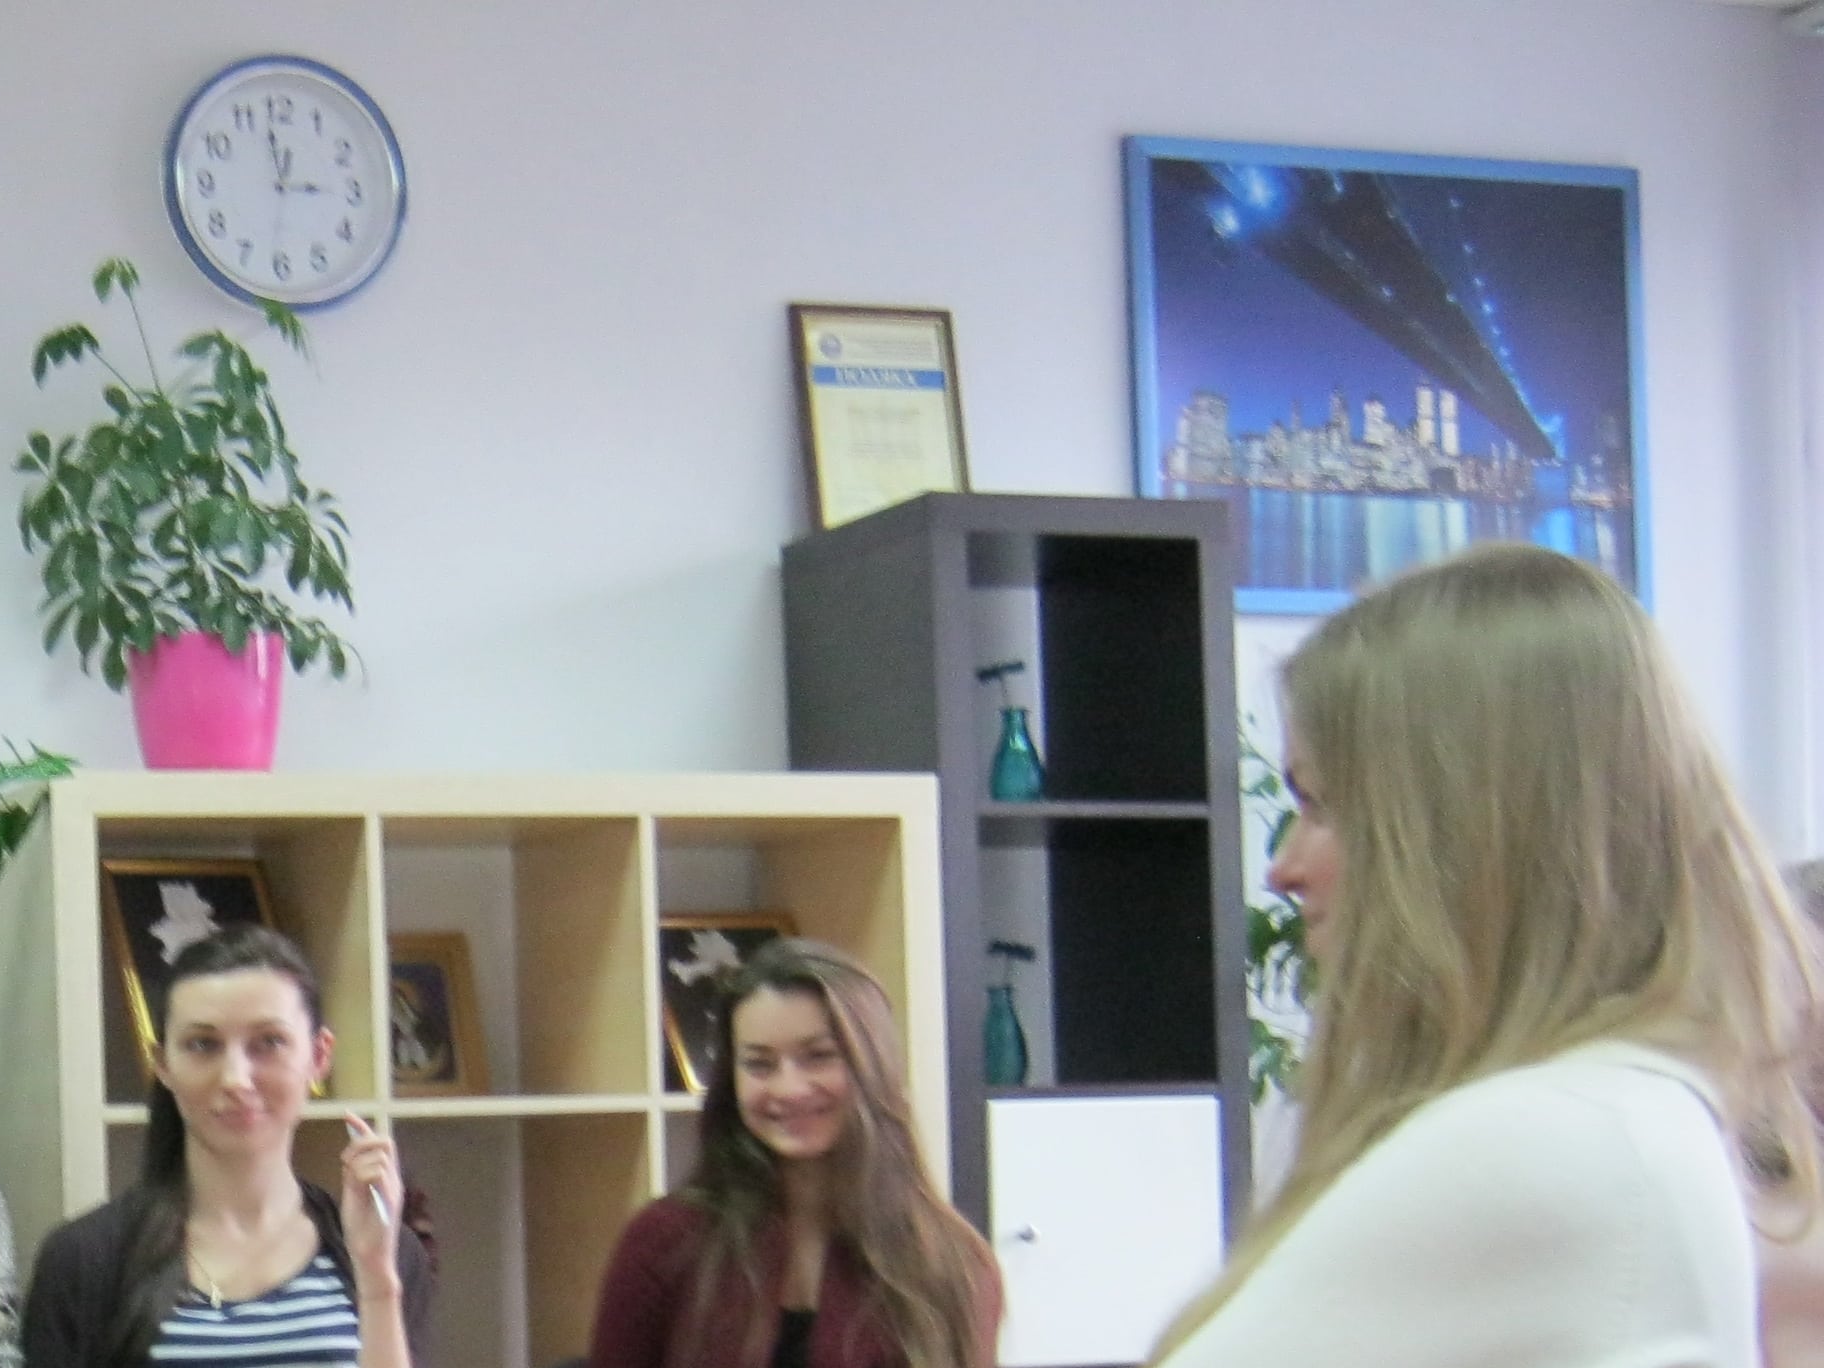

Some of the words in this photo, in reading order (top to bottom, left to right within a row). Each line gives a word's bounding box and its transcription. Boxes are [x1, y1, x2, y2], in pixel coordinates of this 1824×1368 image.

[233, 103, 255, 131] 11
[267, 95, 293, 125] 12
[312, 106, 323, 136] 1
[203, 131, 231, 160] 10
[334, 136, 353, 168] 2
[197, 169, 216, 199] 9
[346, 177, 362, 207] 3
[208, 207, 227, 239] 8
[335, 216, 353, 244] 4
[236, 239, 254, 266] 7
[272, 251, 291, 281] 6
[308, 241, 328, 273] 5
